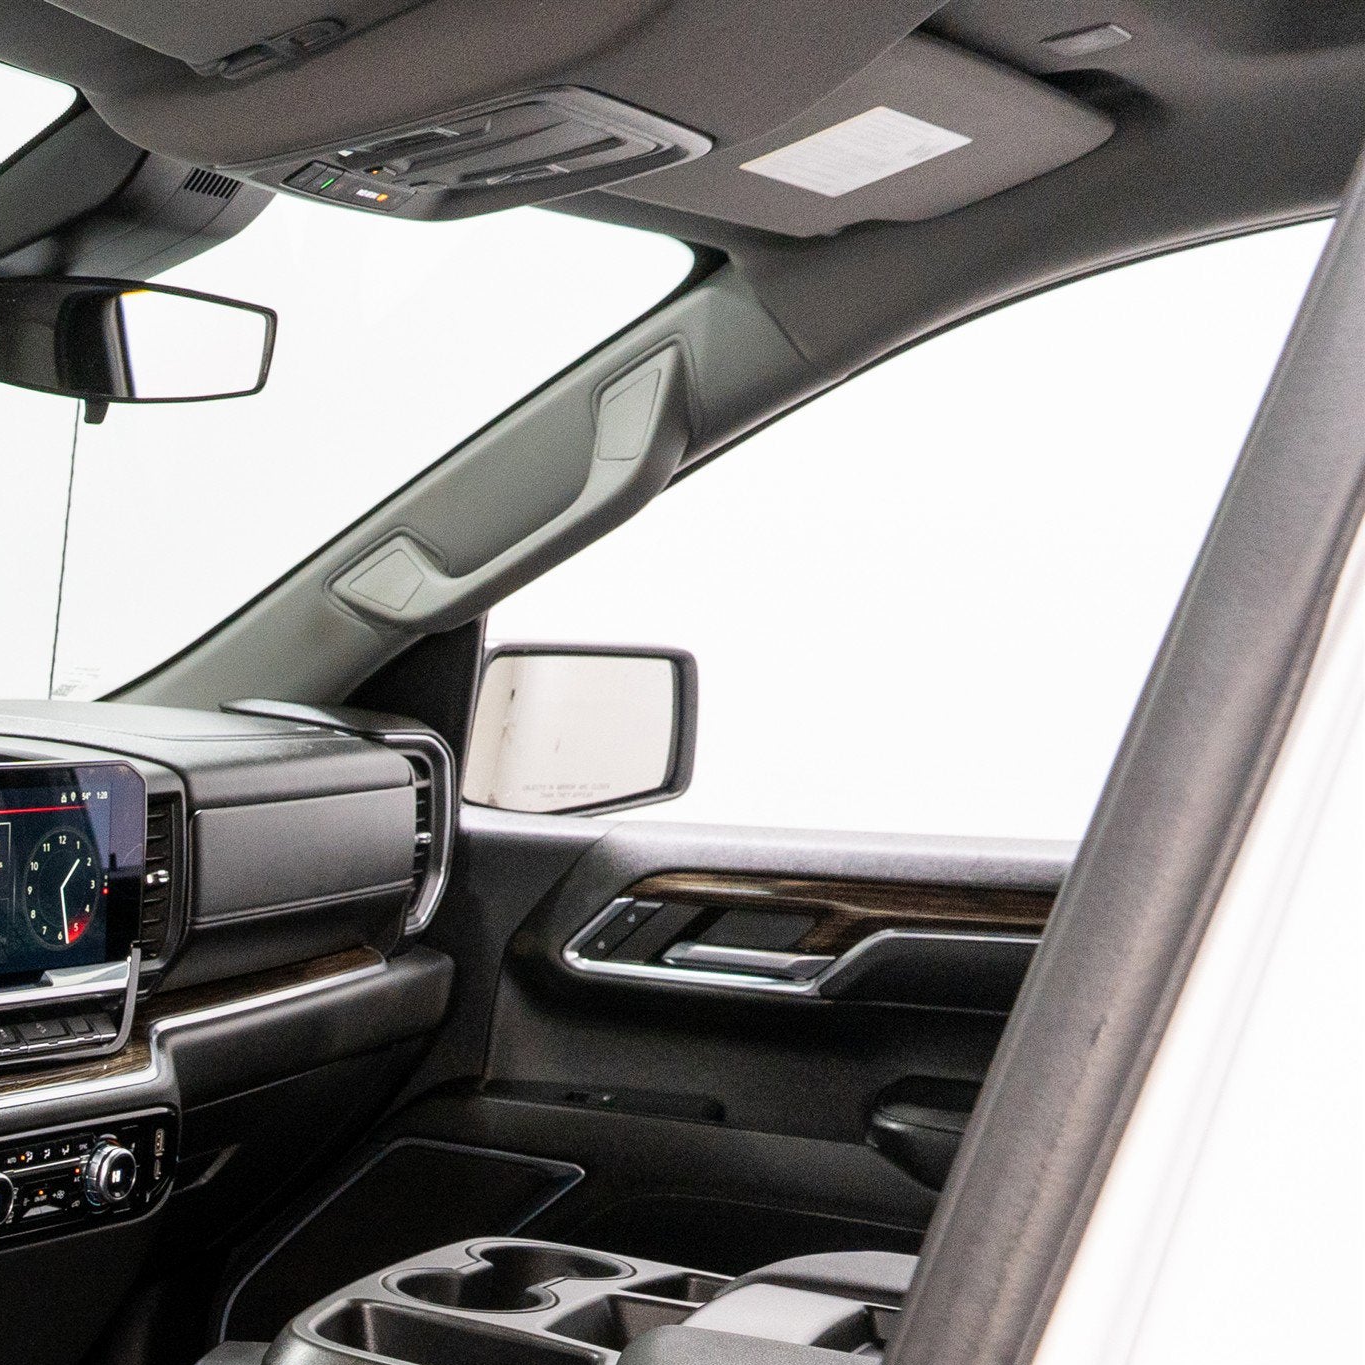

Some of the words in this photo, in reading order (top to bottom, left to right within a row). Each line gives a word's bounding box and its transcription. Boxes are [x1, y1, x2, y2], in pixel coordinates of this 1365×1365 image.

[59, 836, 66, 844] 12
[76, 841, 80, 849] 1
[31, 862, 39, 870] 10
[87, 858, 91, 866] 2
[90, 880, 95, 889] 3
[28, 886, 32, 895] 9
[85, 904, 89, 912] 4
[31, 910, 36, 918] 8
[42, 926, 47, 934] 7
[74, 923, 78, 931] 5
[58, 932, 62, 940] 6
